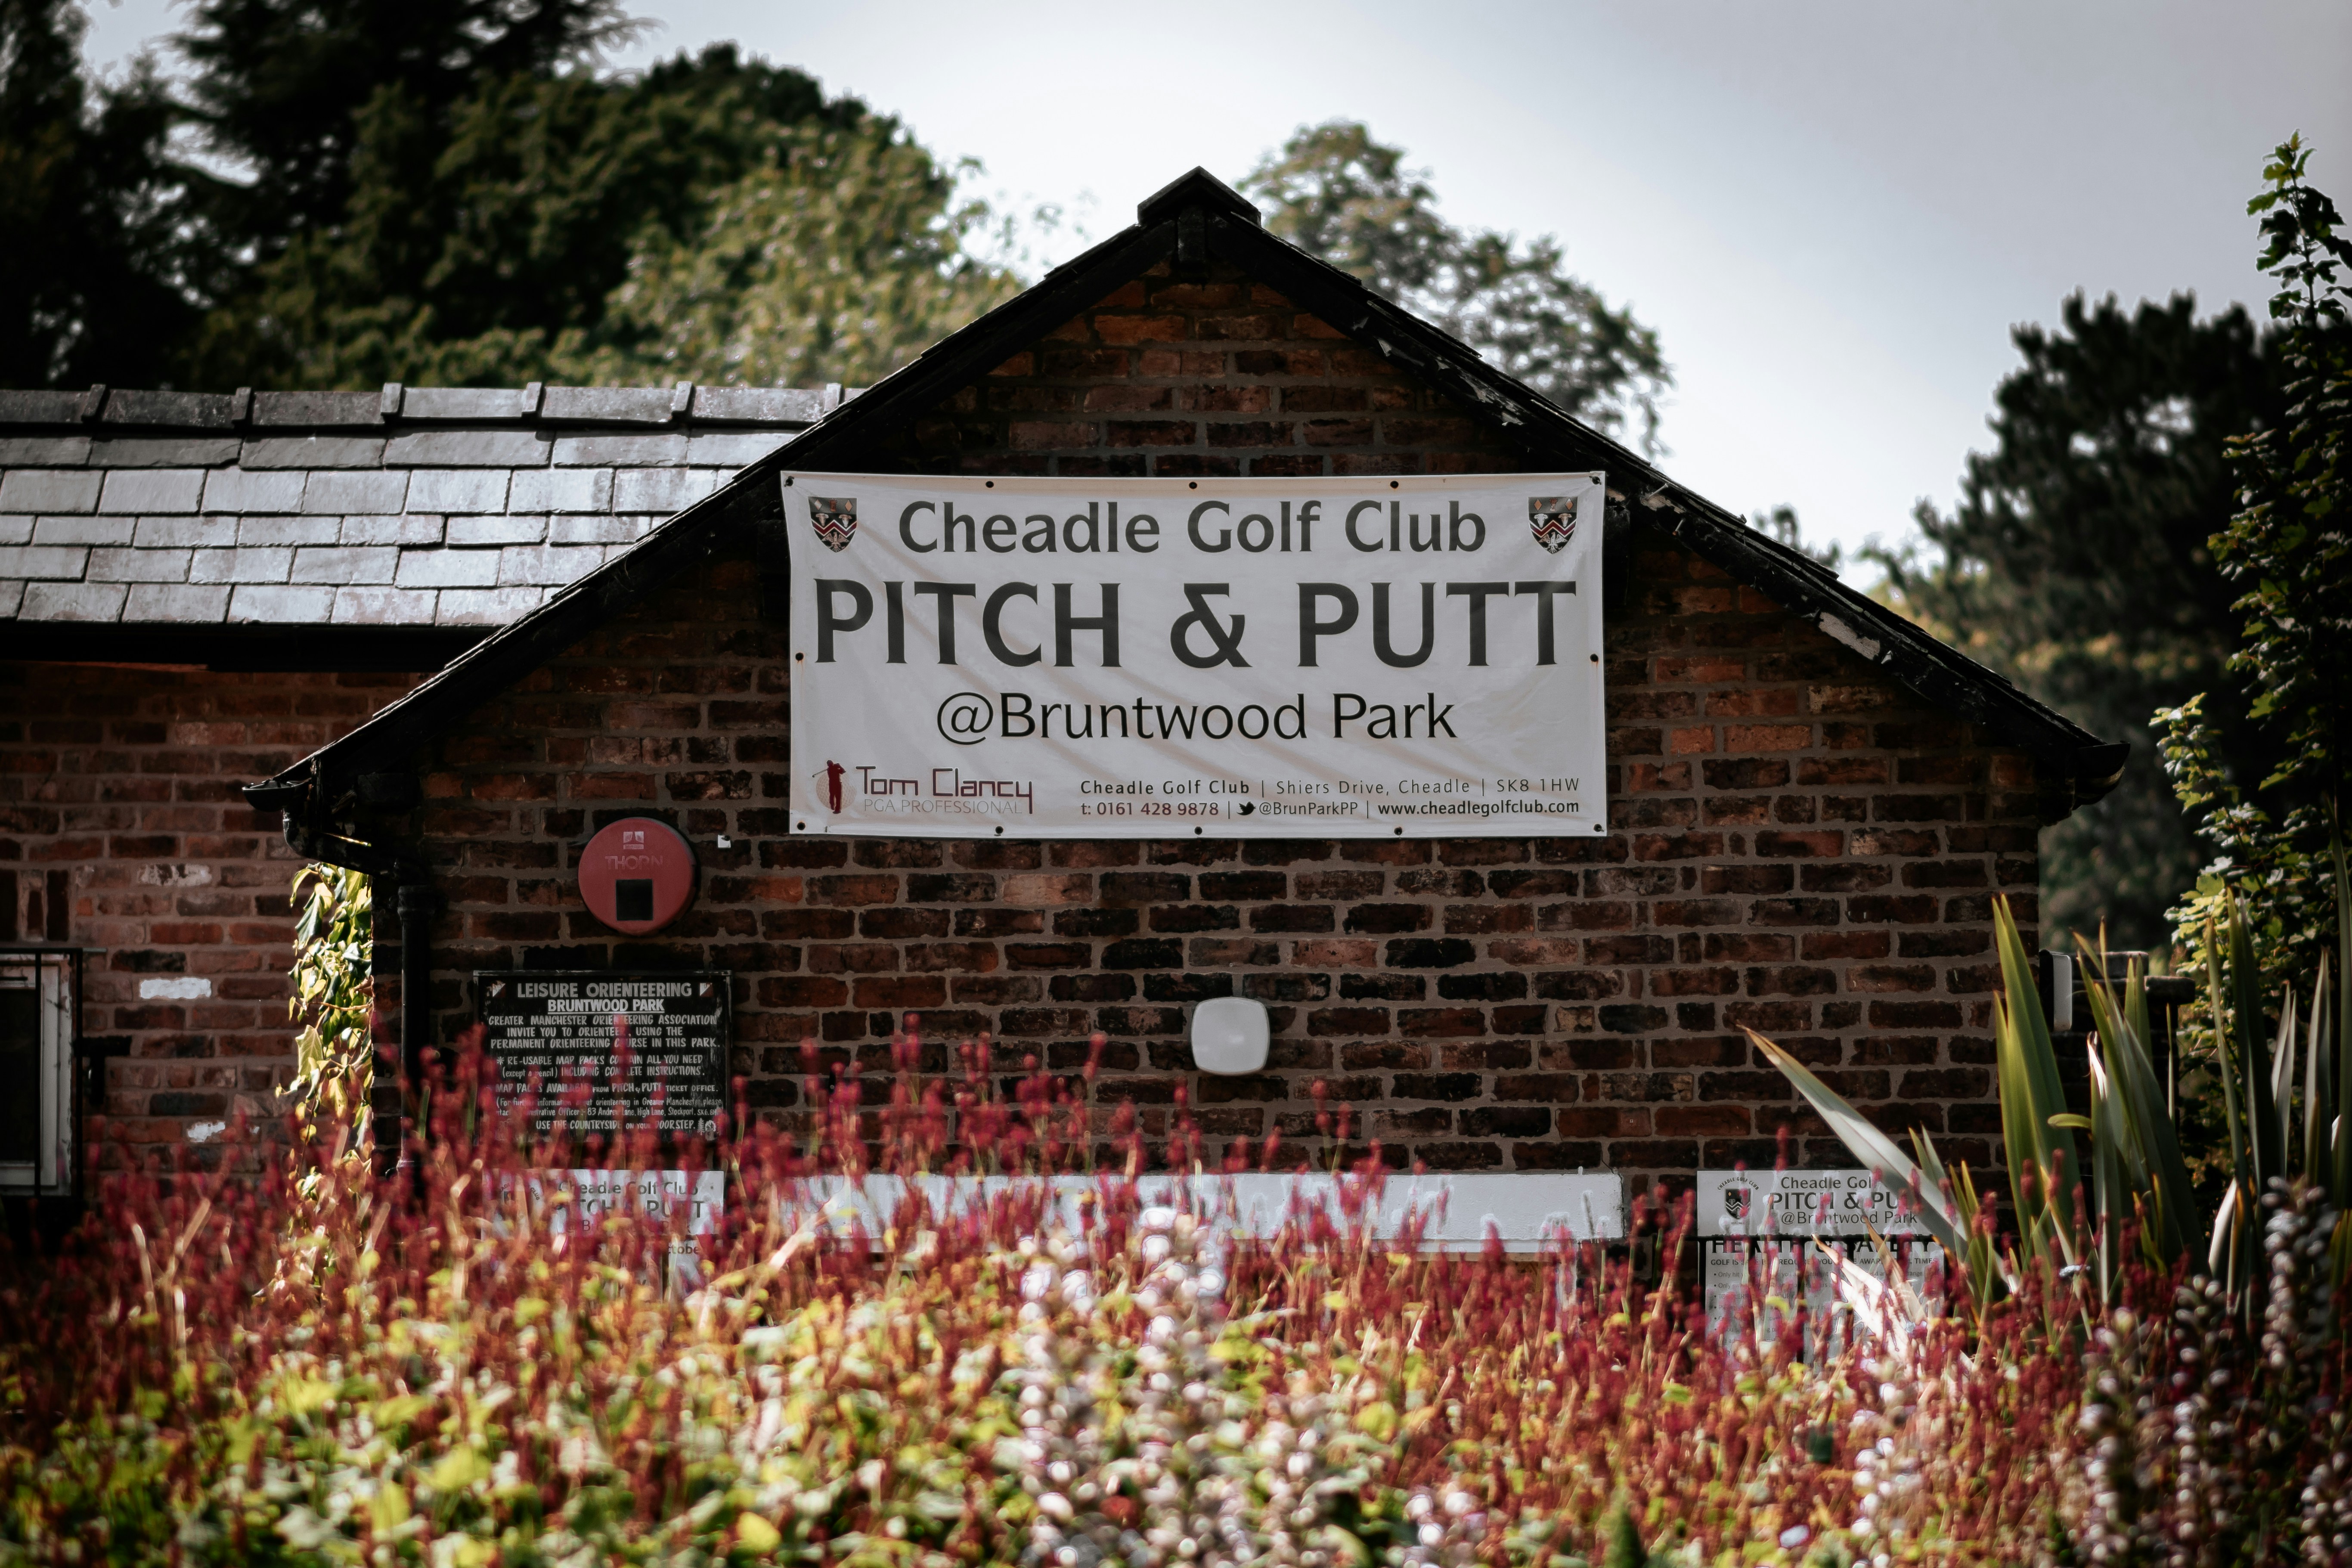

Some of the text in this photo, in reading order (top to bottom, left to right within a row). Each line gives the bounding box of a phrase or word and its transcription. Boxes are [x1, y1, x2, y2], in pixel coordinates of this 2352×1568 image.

[899, 500, 1485, 553] Cheadle Golf Club
[815, 579, 1576, 669] PITCH & PUTT
[937, 692, 1458, 745] @Bruntwood Park
[856, 766, 1032, 814] Tom Clancy
[1081, 778, 1579, 796] Cheadle Golf Club Shiers Drive, Cheadle SK8 1HW
[865, 799, 1022, 814] PGA PROFESSIONAL
[1081, 799, 1579, 817] t: 0161 428 9878 @BrunParkPP www.cheadlegolfclub.com
[605, 855, 663, 870] THORN
[518, 982, 692, 998] LEISURE ORIENTEERING
[548, 998, 664, 1011] BRUNTWOOD PARK
[489, 1015, 524, 1025] GREATER
[531, 1015, 587, 1025] MANCHESTER
[658, 1014, 717, 1025] ASSOCIATION
[507, 1026, 683, 1037] INVITE YOU TO ORIENTEE, USING THE
[491, 1038, 720, 1049] PERMANENT ORIENTEERING CURSE IN THIS PARK.
[508, 1056, 552, 1065] RE-USABLE
[556, 1056, 574, 1065] MAP
[579, 1055, 604, 1065] PACKS
[647, 1054, 661, 1064] ALL
[663, 1054, 679, 1064] YOU
[682, 1054, 703, 1064] NEED
[502, 1066, 525, 1079] (except
[647, 1065, 705, 1075] INSTRUCTIONS.
[496, 1083, 513, 1093] MAP
[517, 1083, 542, 1093] PACS
[612, 1082, 634, 1092] PITCH
[641, 1082, 662, 1092] PUTT
[596, 1097, 630, 1107] orienteering
[642, 1097, 664, 1106] Greater
[587, 1107, 596, 1116] 83
[637, 1108, 650, 1118] High
[536, 1120, 550, 1129] USE
[553, 1120, 567, 1129] THE
[1717, 1178, 1735, 1190] CHEADLE
[1749, 1181, 1759, 1190] CLUB
[1781, 1176, 1872, 1189] Cheadle Gol
[1871, 1192, 1898, 1209] PU
